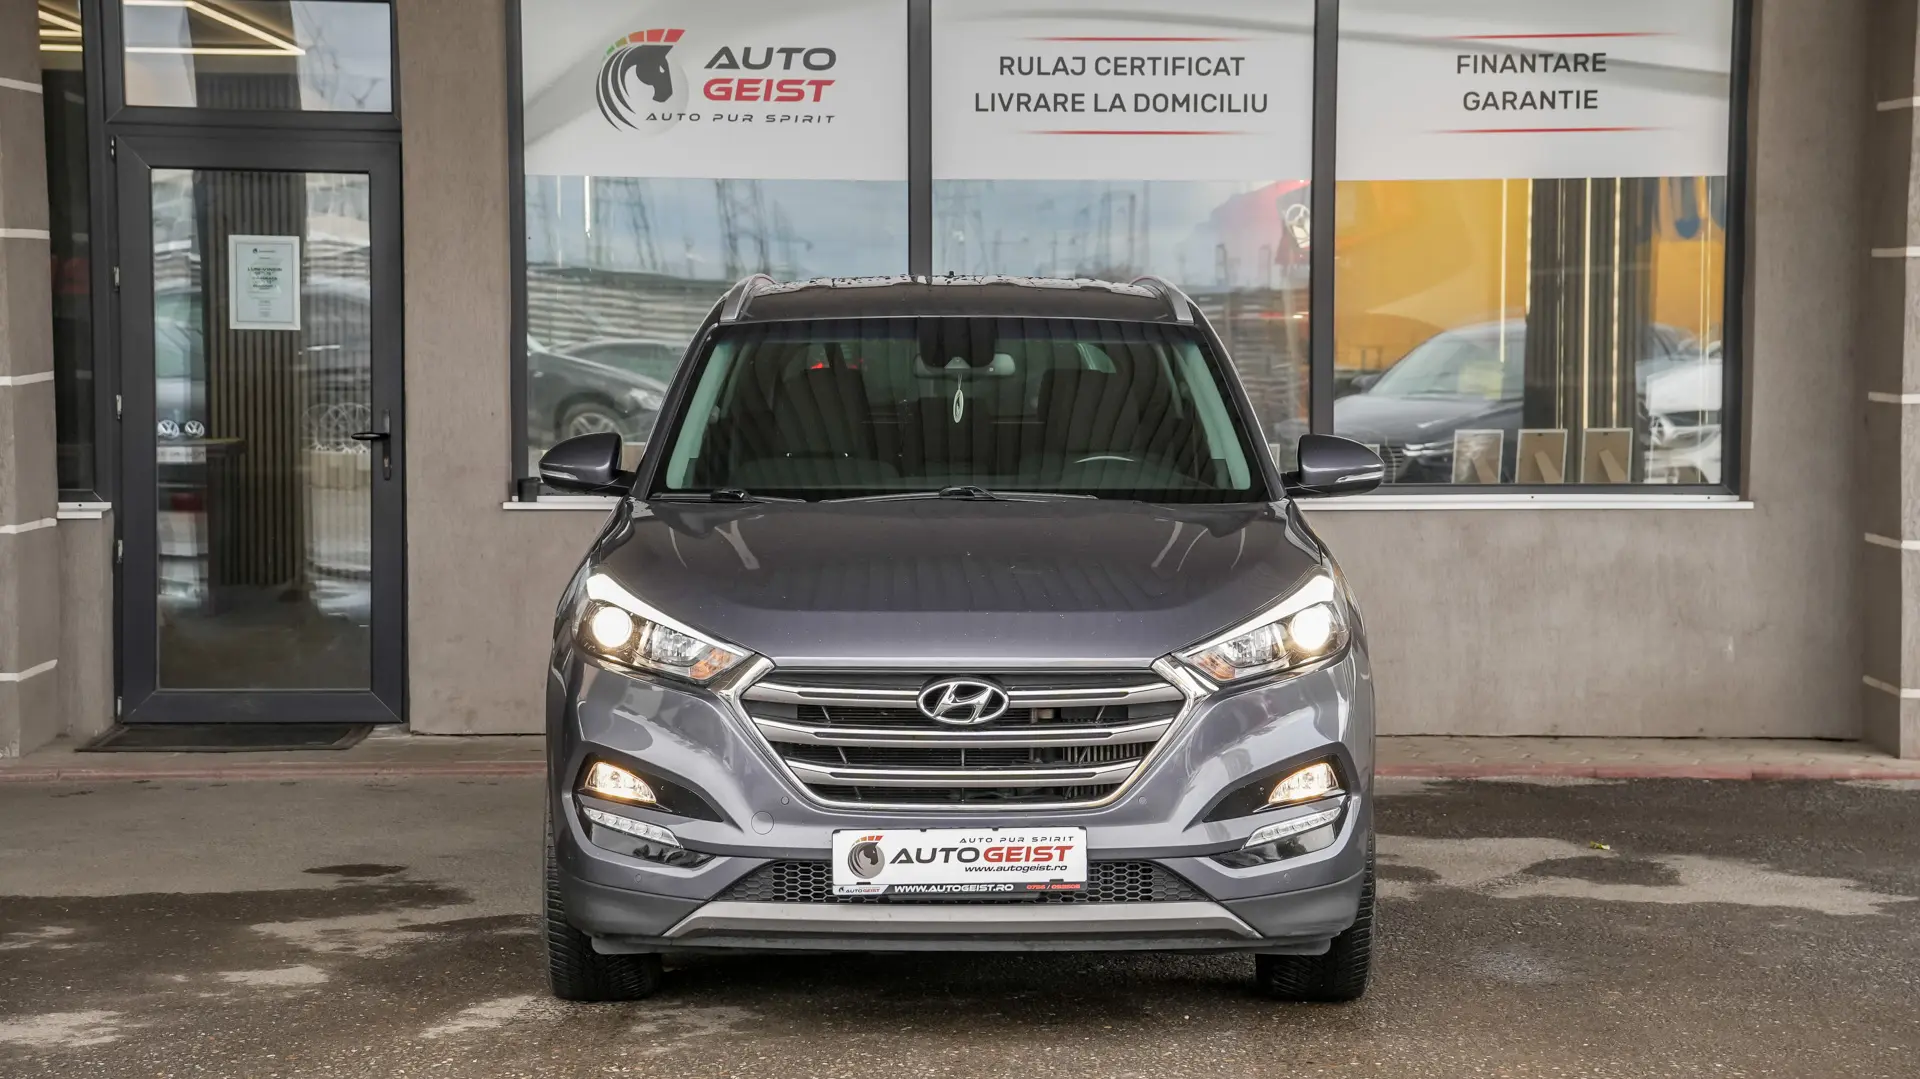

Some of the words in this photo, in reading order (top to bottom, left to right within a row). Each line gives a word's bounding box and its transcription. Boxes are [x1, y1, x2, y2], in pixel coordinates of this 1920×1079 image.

[704, 46, 837, 71] AUTO
[999, 56, 1086, 76] RULAJ
[1094, 56, 1245, 76] CERTIFICAT
[1456, 52, 1607, 74] FINANTARE
[703, 78, 836, 103] GEIST
[1463, 89, 1599, 111] GARANTIE
[975, 92, 1086, 112] LIVRARE
[1093, 93, 1127, 112] LA
[1133, 93, 1268, 113] DOMICILIU
[645, 113, 701, 122] AUTO
[712, 113, 753, 123] PUR
[765, 114, 837, 125] SPIRIT
[965, 864, 1068, 873] www.autogeist.ro
[894, 884, 1014, 893] WWW.AUTOGEIST.RO
